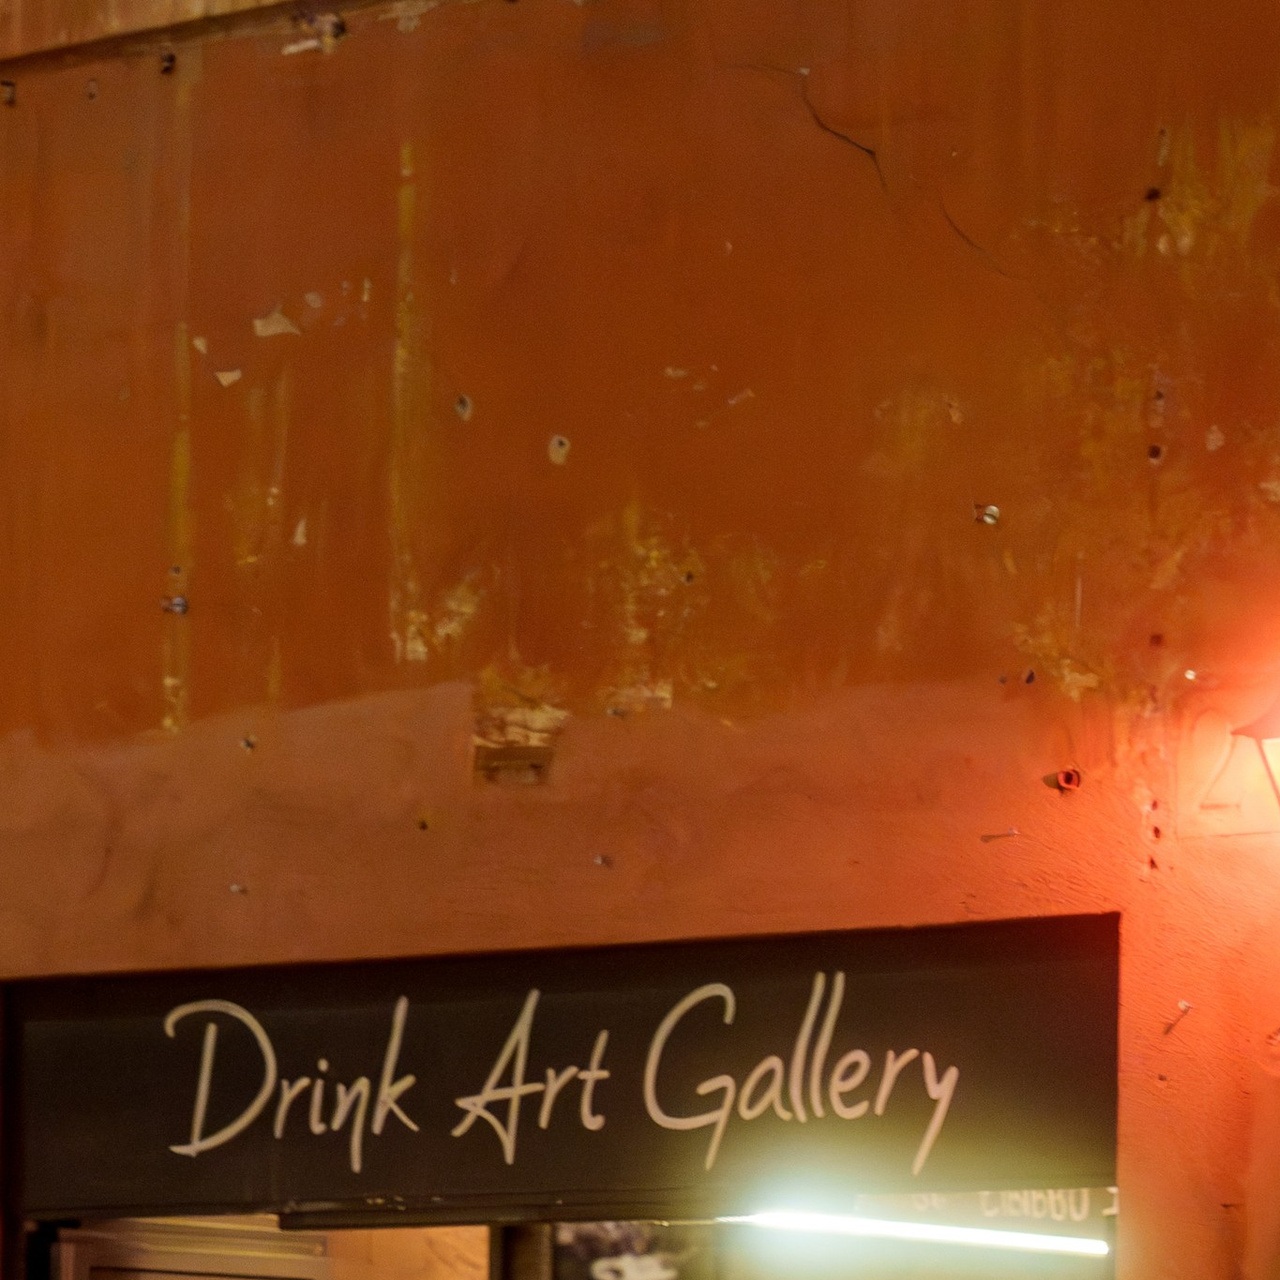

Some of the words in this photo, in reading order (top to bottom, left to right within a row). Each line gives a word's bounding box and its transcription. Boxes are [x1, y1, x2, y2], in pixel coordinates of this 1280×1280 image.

[164, 995, 419, 1173] Drink
[451, 989, 610, 1165] Art
[644, 970, 960, 1175] Gallery
